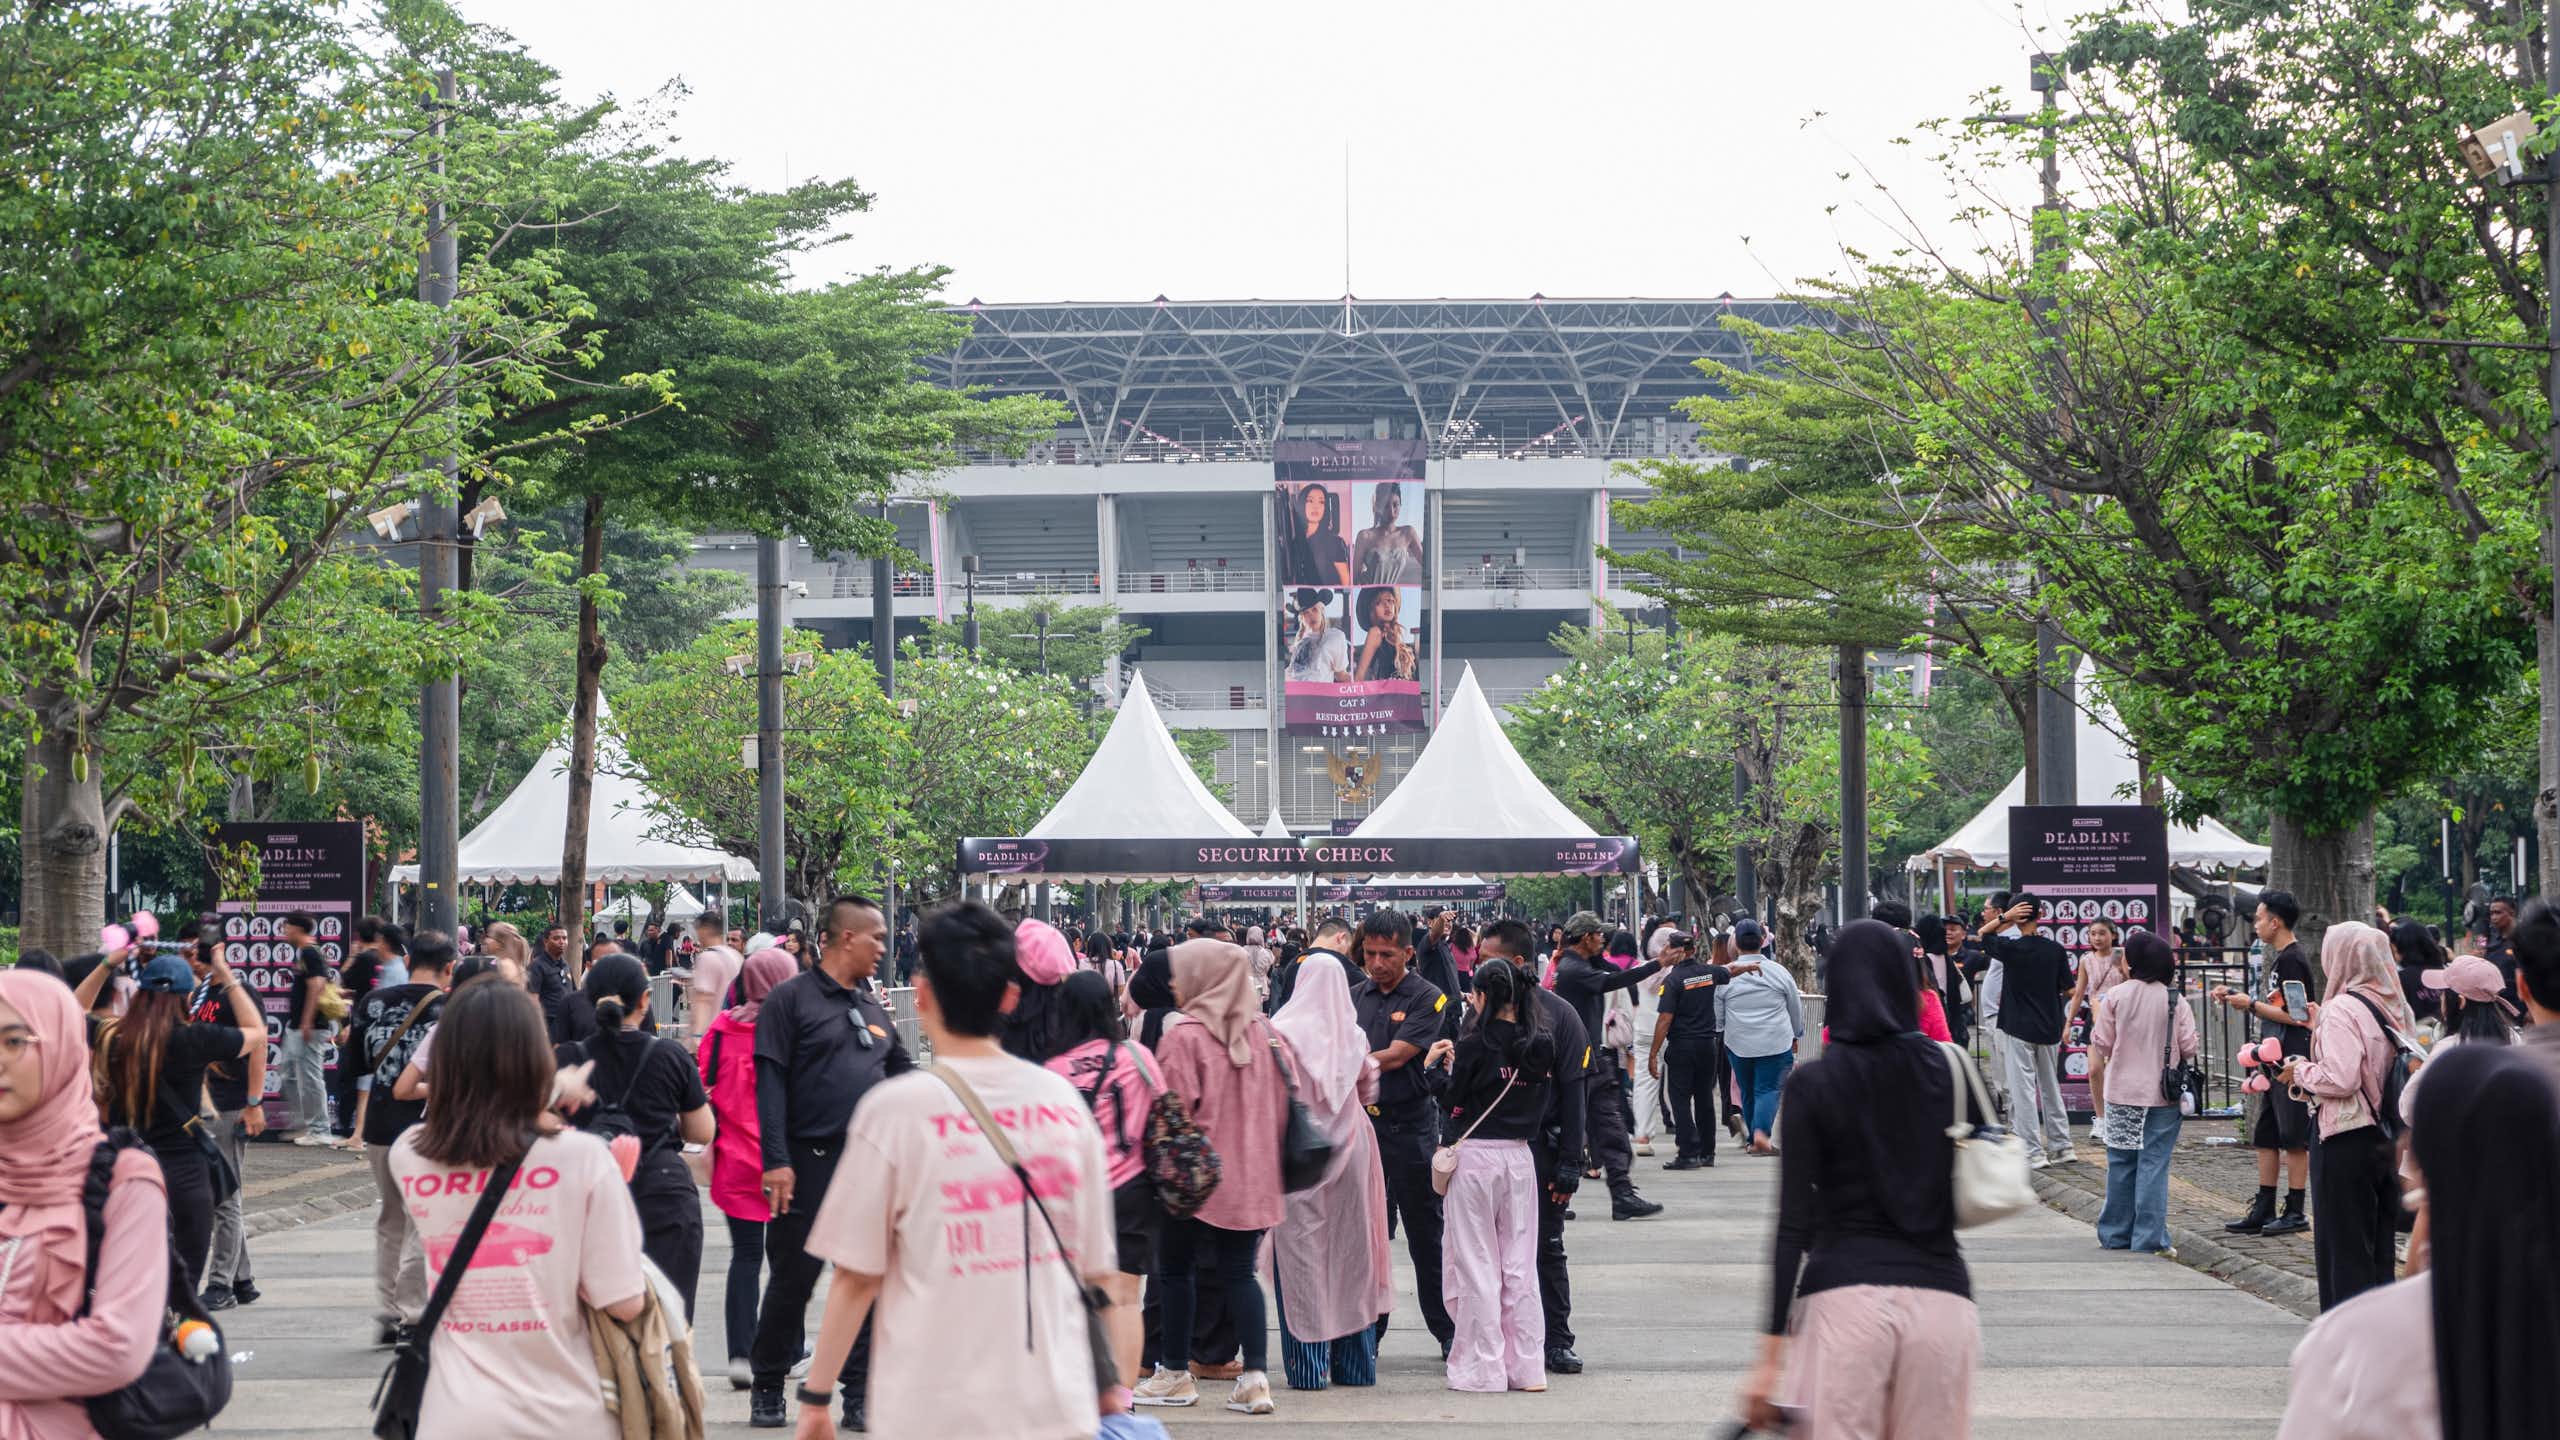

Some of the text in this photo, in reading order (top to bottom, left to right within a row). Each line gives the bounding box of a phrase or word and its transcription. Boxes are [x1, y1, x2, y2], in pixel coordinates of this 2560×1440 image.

[1340, 685, 1357, 694] CAT
[1340, 698, 1366, 707] CAT 3
[1316, 710, 1394, 721] RESTRICTED VIEW
[2044, 832, 2131, 844] DEADLINE
[978, 852, 1034, 861] DEADLINE
[1198, 847, 1395, 862] SECURITY CHECK
[1557, 851, 1614, 861] DEADLINE
[1241, 889, 1280, 897] TICKET
[1397, 888, 1464, 897] TICKET SCAN
[477, 1320, 548, 1333] CLASSIC
